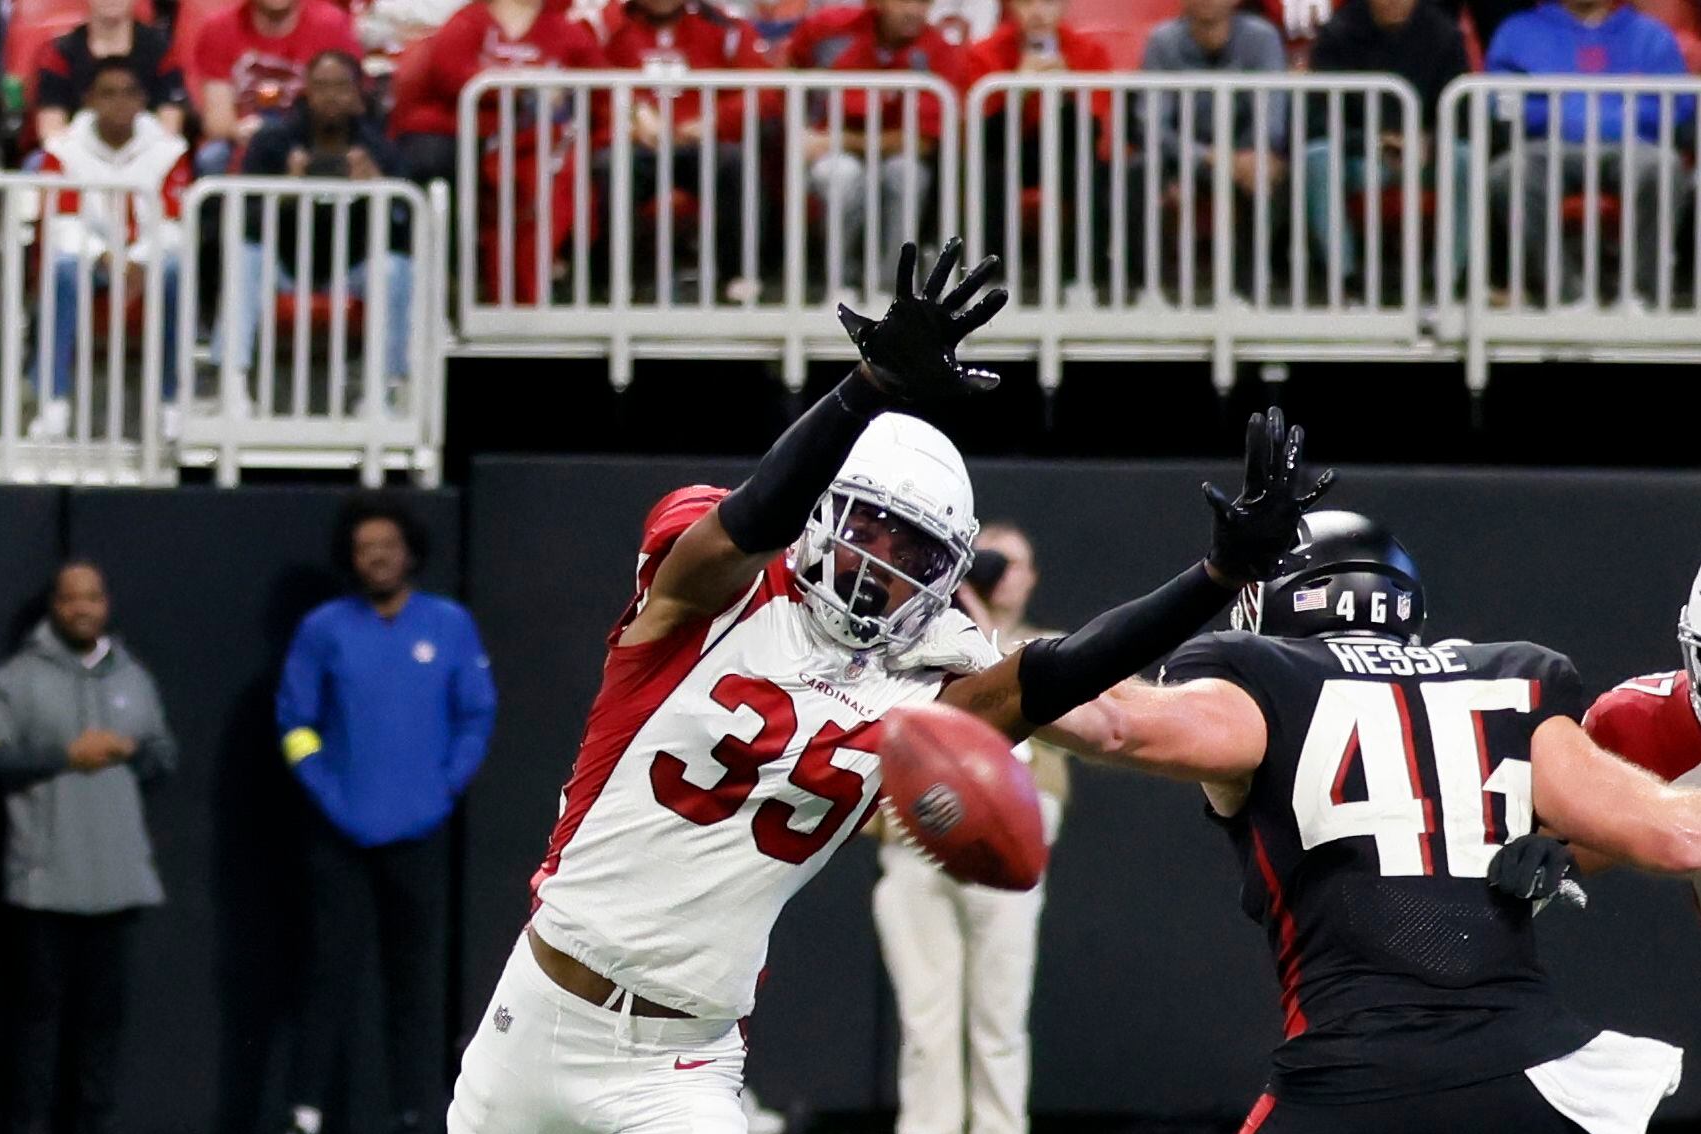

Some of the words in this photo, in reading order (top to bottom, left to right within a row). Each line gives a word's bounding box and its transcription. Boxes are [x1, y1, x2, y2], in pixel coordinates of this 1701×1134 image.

[1327, 642, 1468, 676] HESSE
[1336, 590, 1388, 624] 46
[649, 673, 882, 865] 35
[1292, 678, 1541, 878] 46
